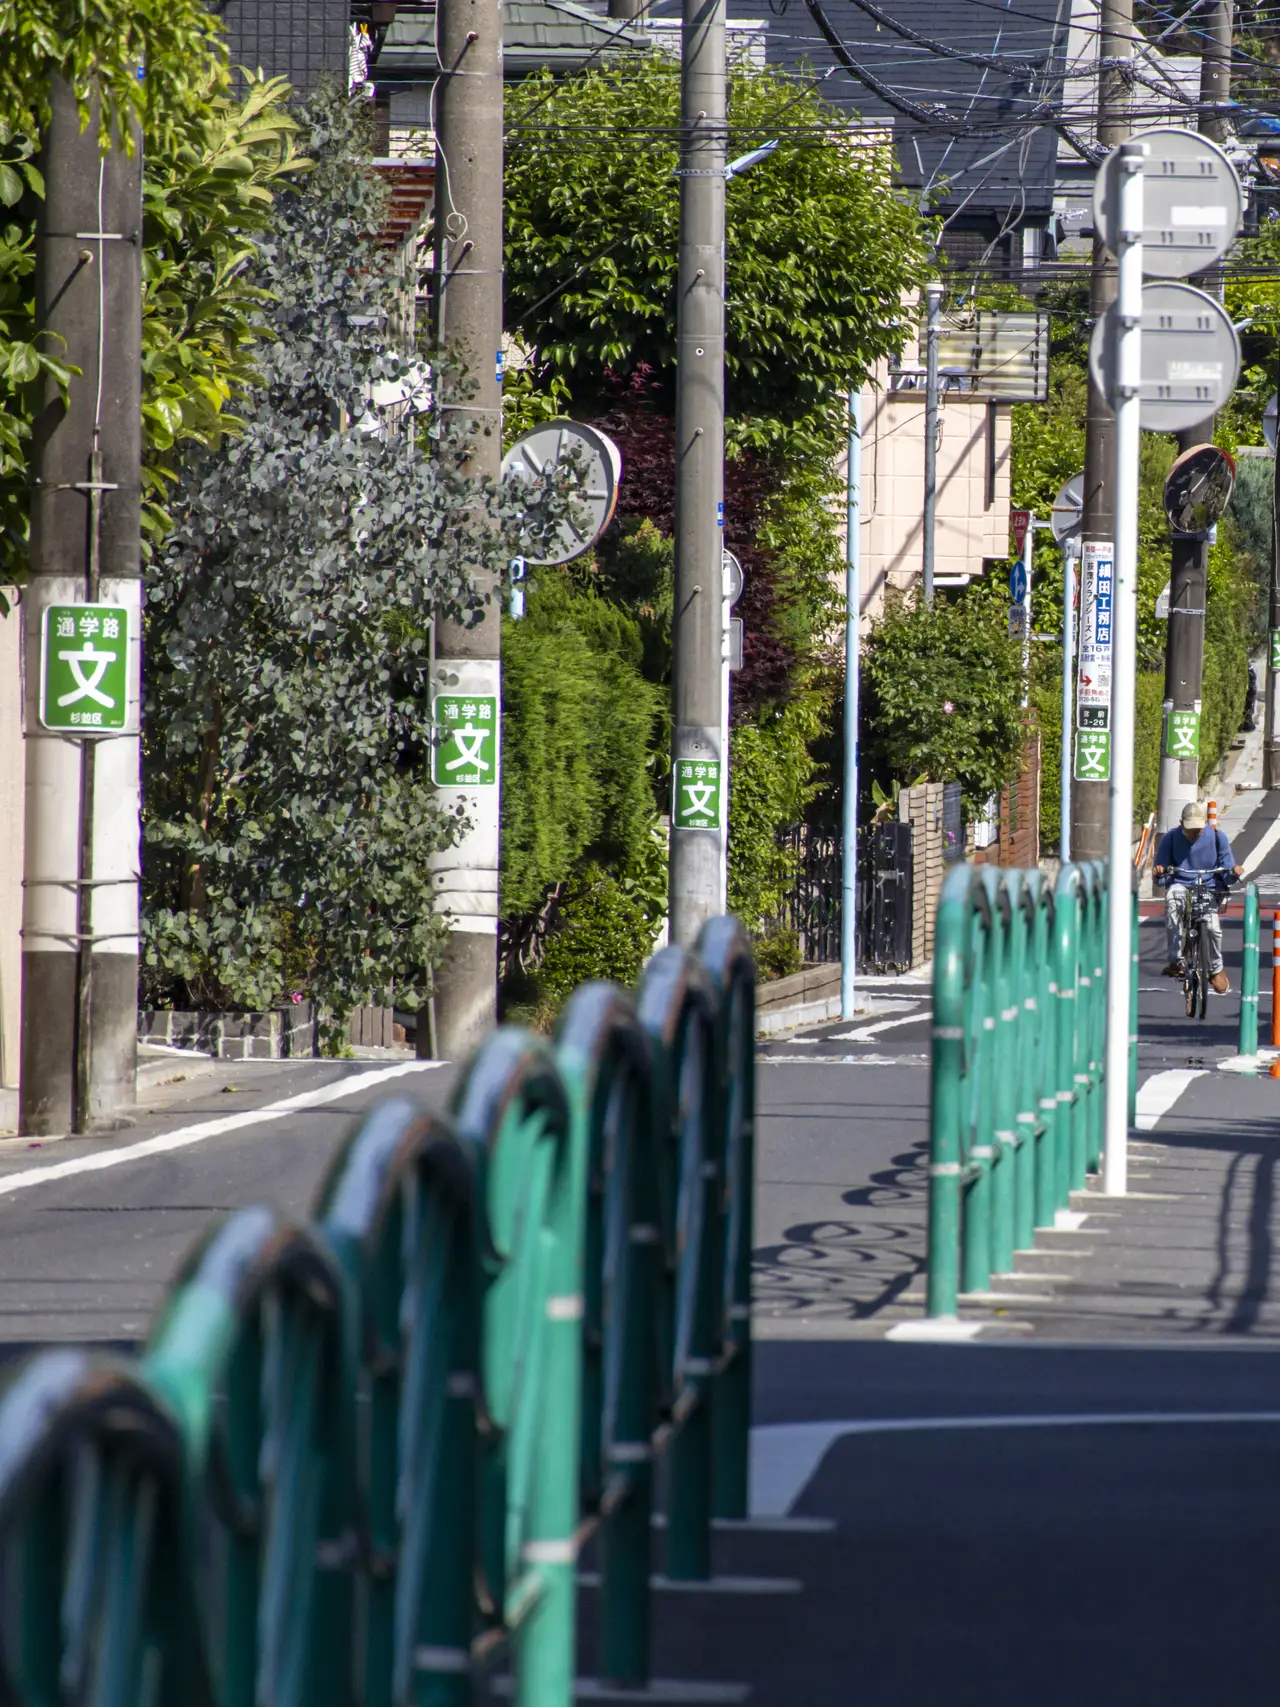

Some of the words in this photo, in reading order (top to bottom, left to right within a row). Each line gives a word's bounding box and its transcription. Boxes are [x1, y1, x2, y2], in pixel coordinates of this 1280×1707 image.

[56, 616, 119, 638] 通学路
[57, 641, 117, 708] 文
[70, 712, 102, 724] 杉並区
[444, 704, 491, 719] 通学路
[445, 722, 490, 770] 文
[1080, 735, 1107, 744] 通学路
[1172, 726, 1196, 750] 文
[1081, 745, 1106, 772] 文
[681, 766, 717, 779] 通学路
[681, 780, 716, 817] 文
